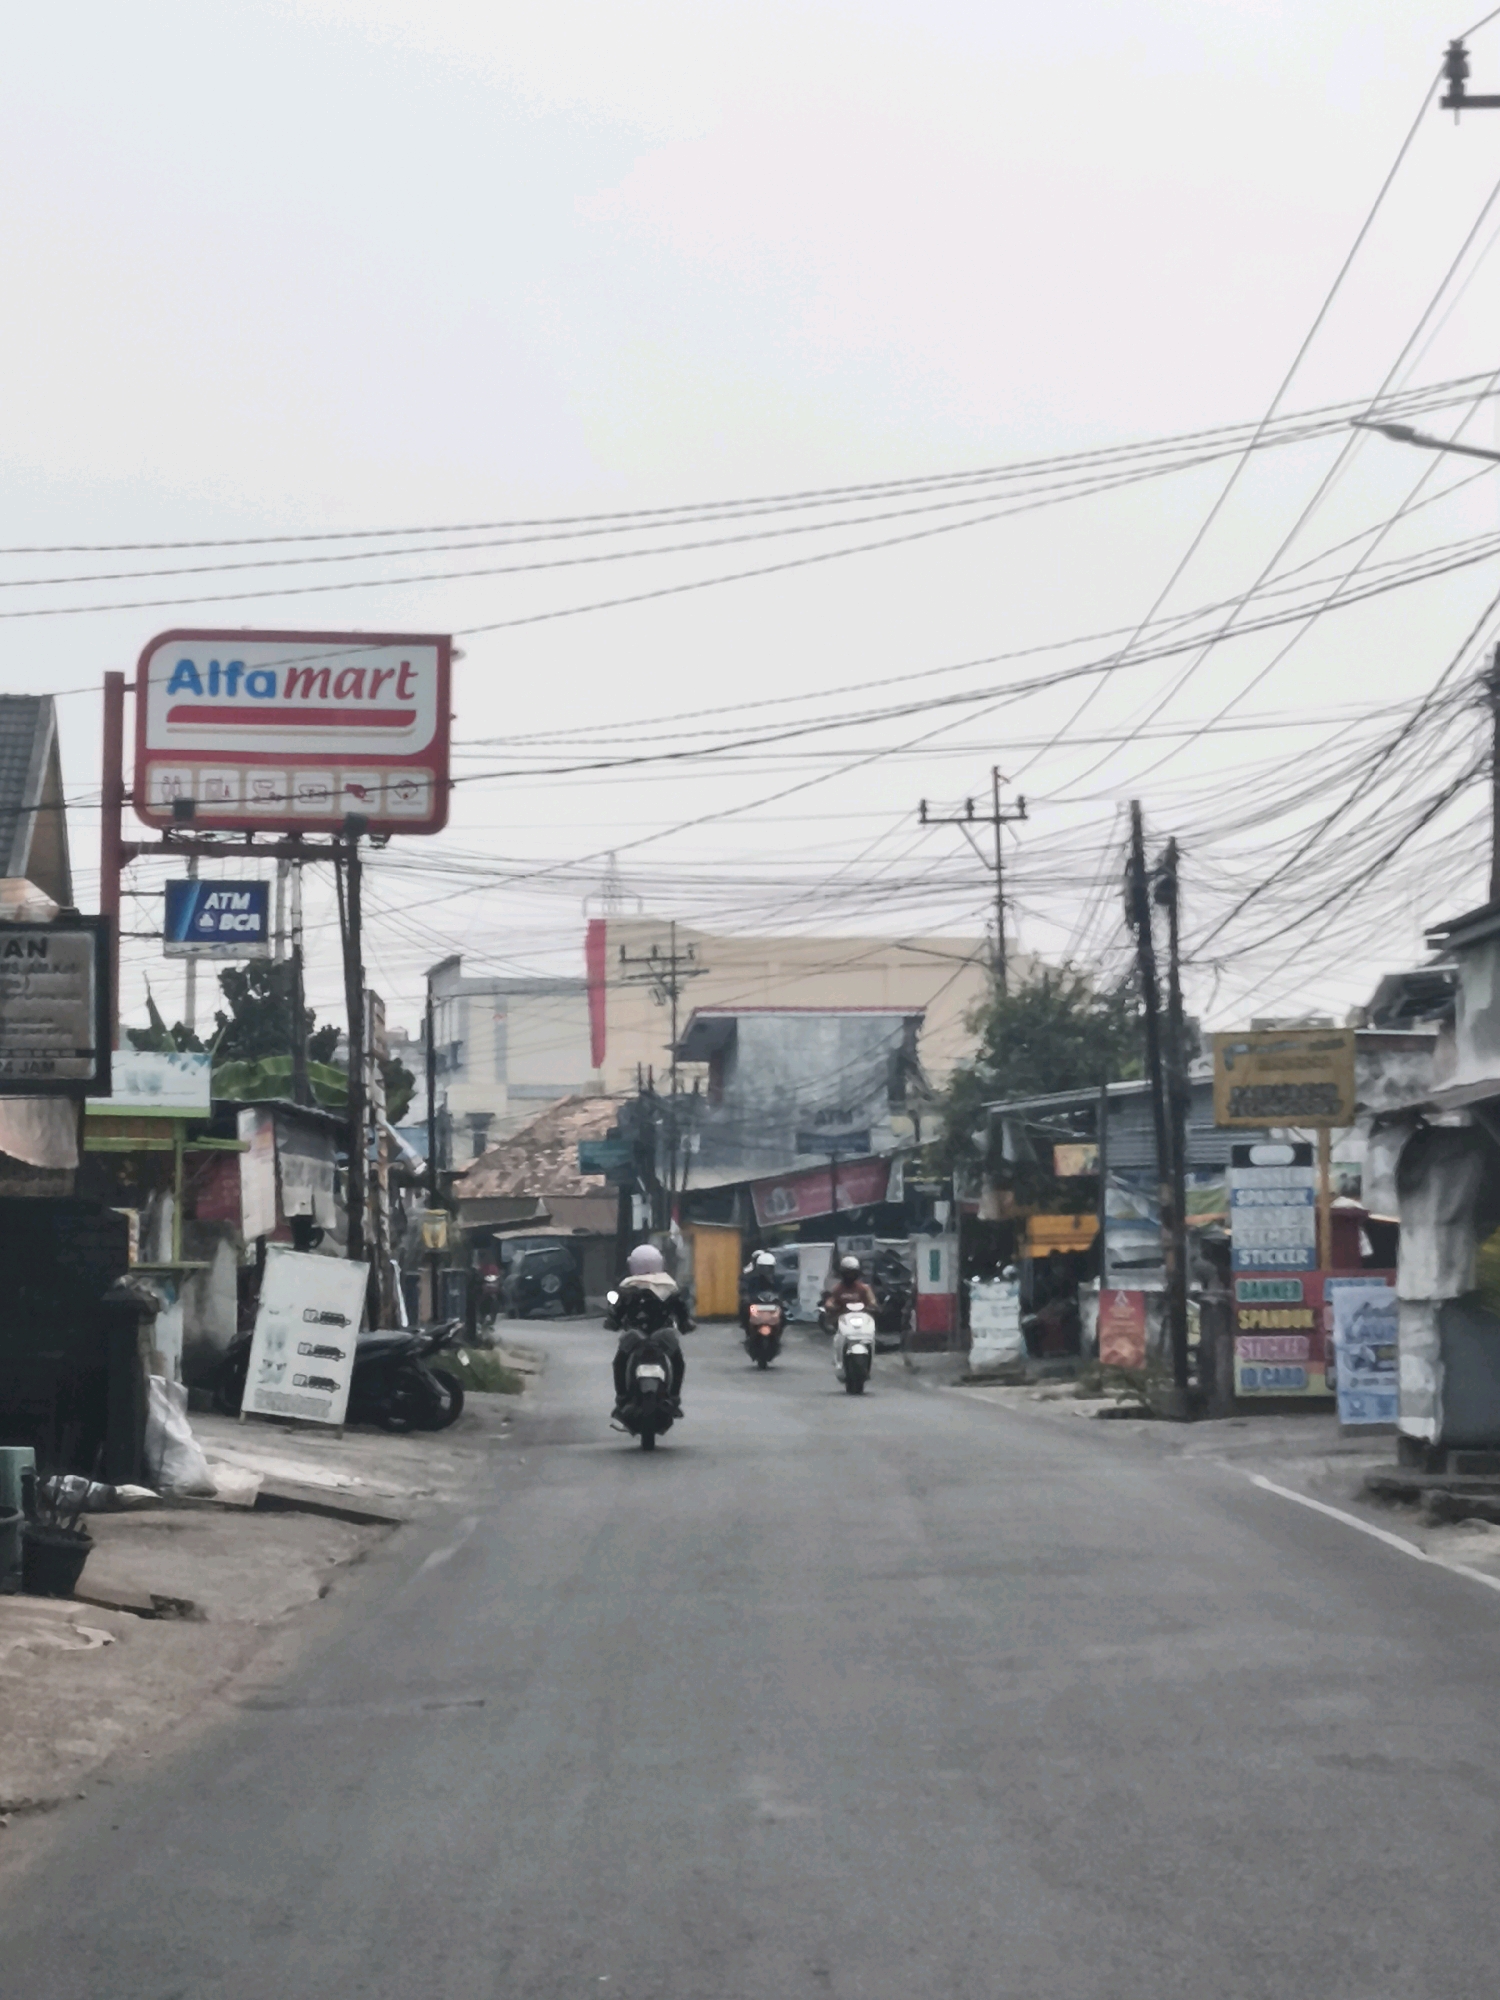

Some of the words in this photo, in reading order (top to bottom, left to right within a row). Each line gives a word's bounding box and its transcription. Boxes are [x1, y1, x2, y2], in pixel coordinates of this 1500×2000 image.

[166, 659, 418, 700] Alfamart
[204, 892, 250, 910] ATM
[219, 913, 260, 931] BCA
[1238, 1249, 1308, 1265] STICKER
[1238, 1308, 1315, 1330] SPANDUK
